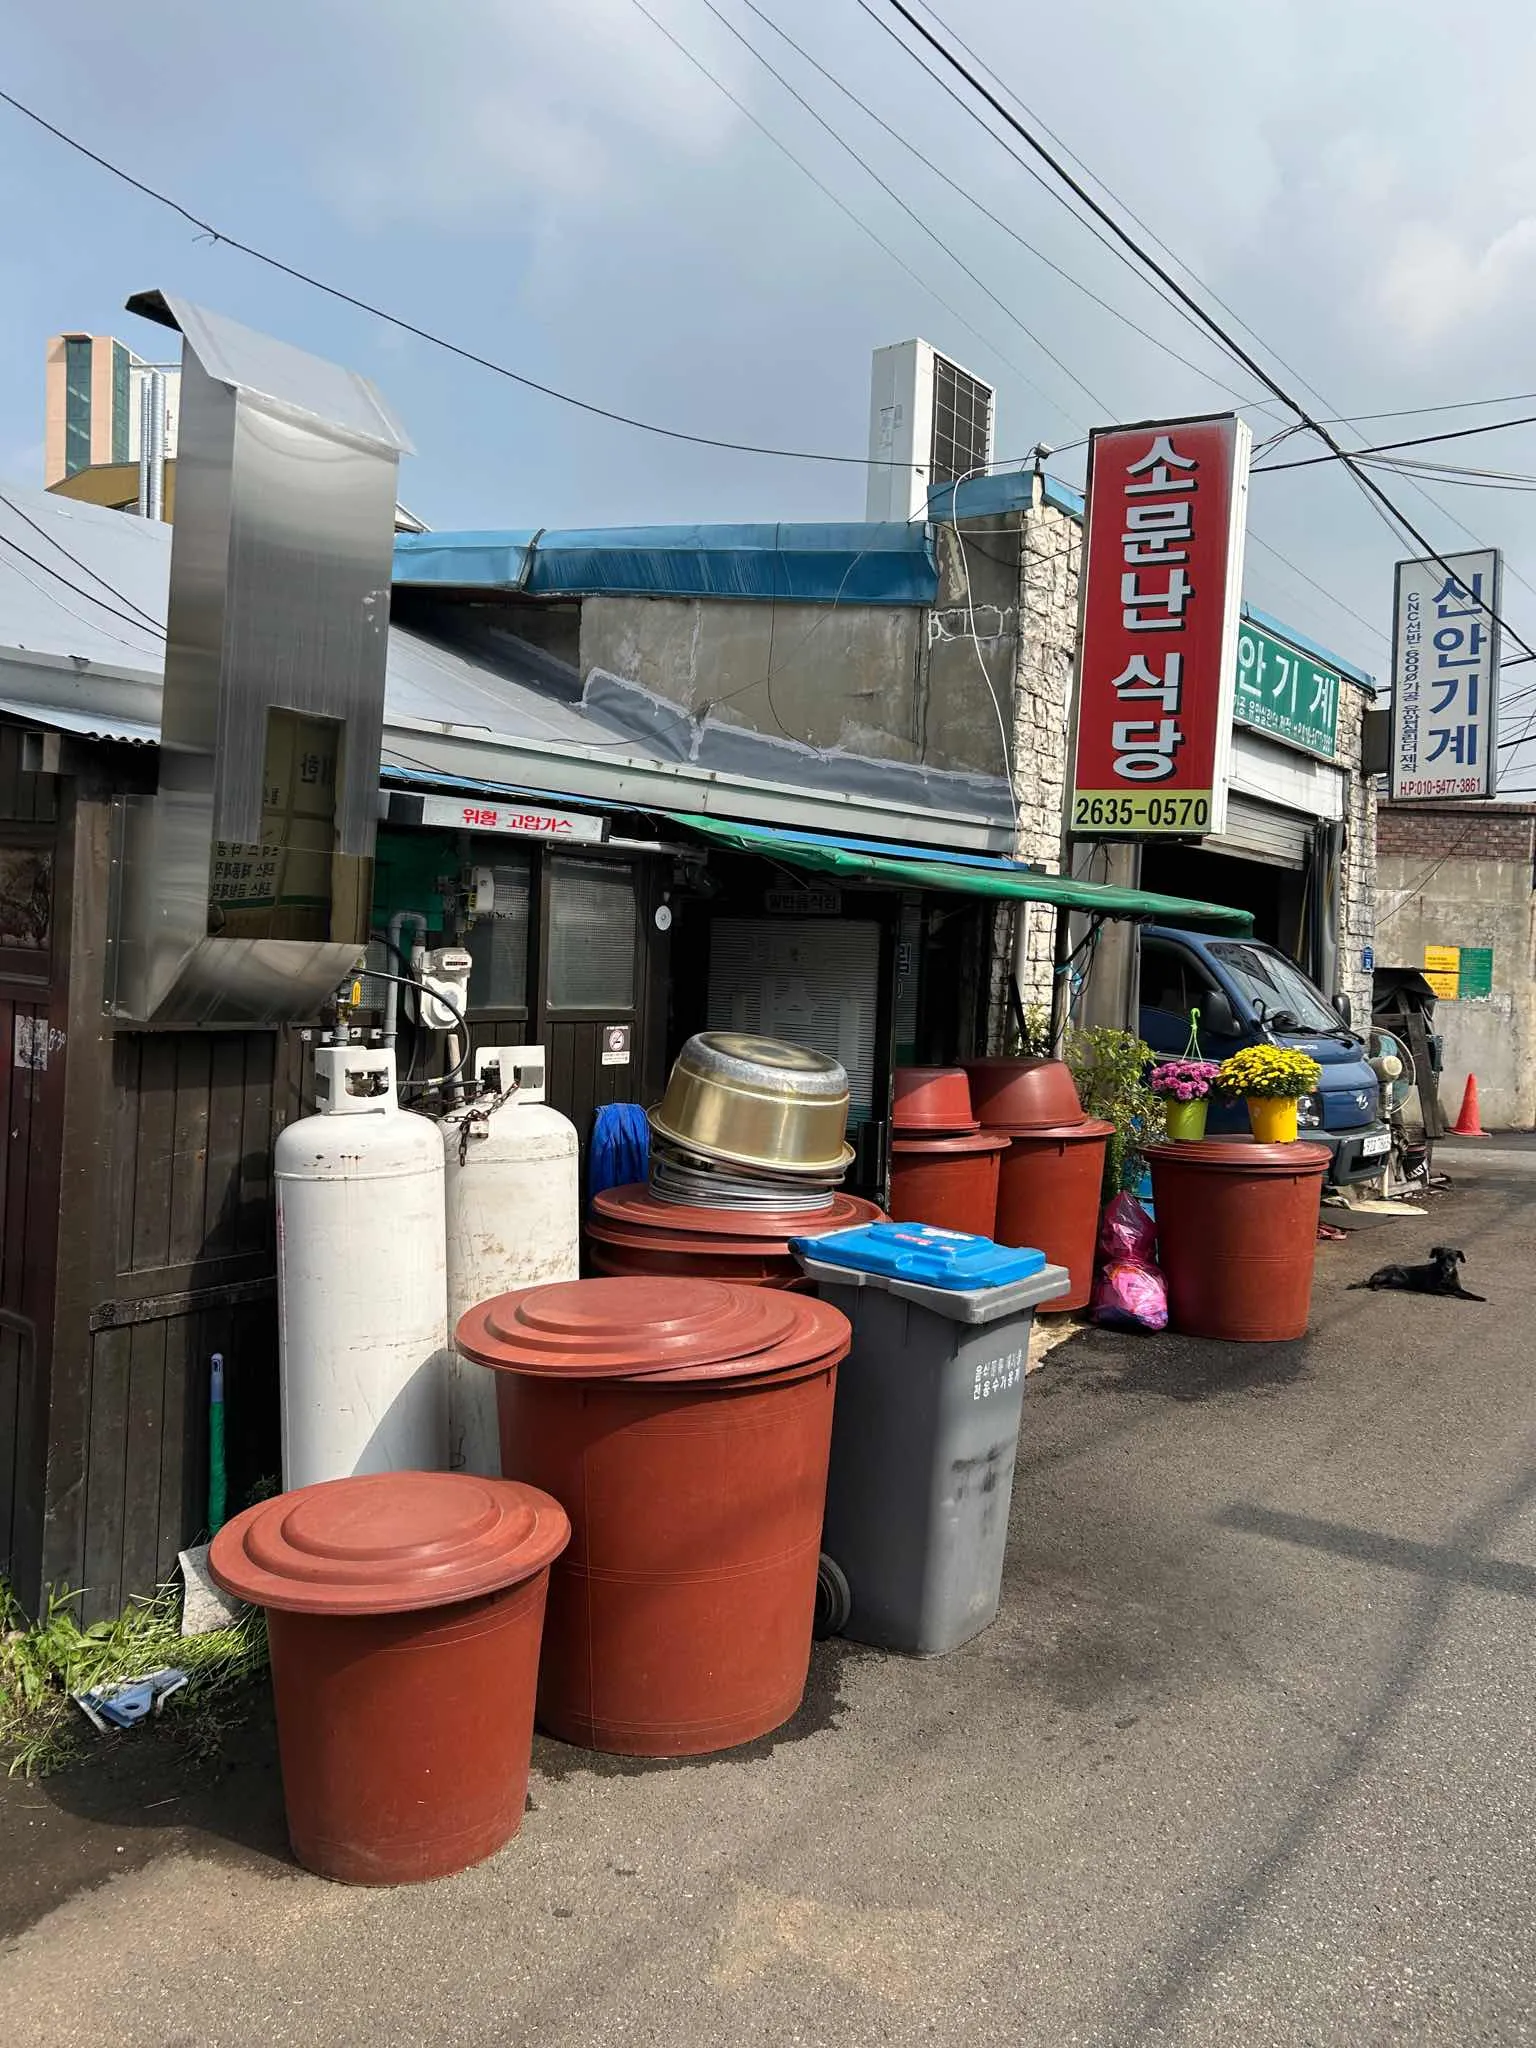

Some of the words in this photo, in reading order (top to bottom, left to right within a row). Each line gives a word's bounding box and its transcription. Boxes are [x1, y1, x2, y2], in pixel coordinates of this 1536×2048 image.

[1121, 435, 1197, 631] 소문난
[1111, 652, 1184, 781] 식당
[462, 807, 497, 826] 위험
[506, 813, 573, 833] 고압가스
[1075, 797, 1208, 826] 2635-0570
